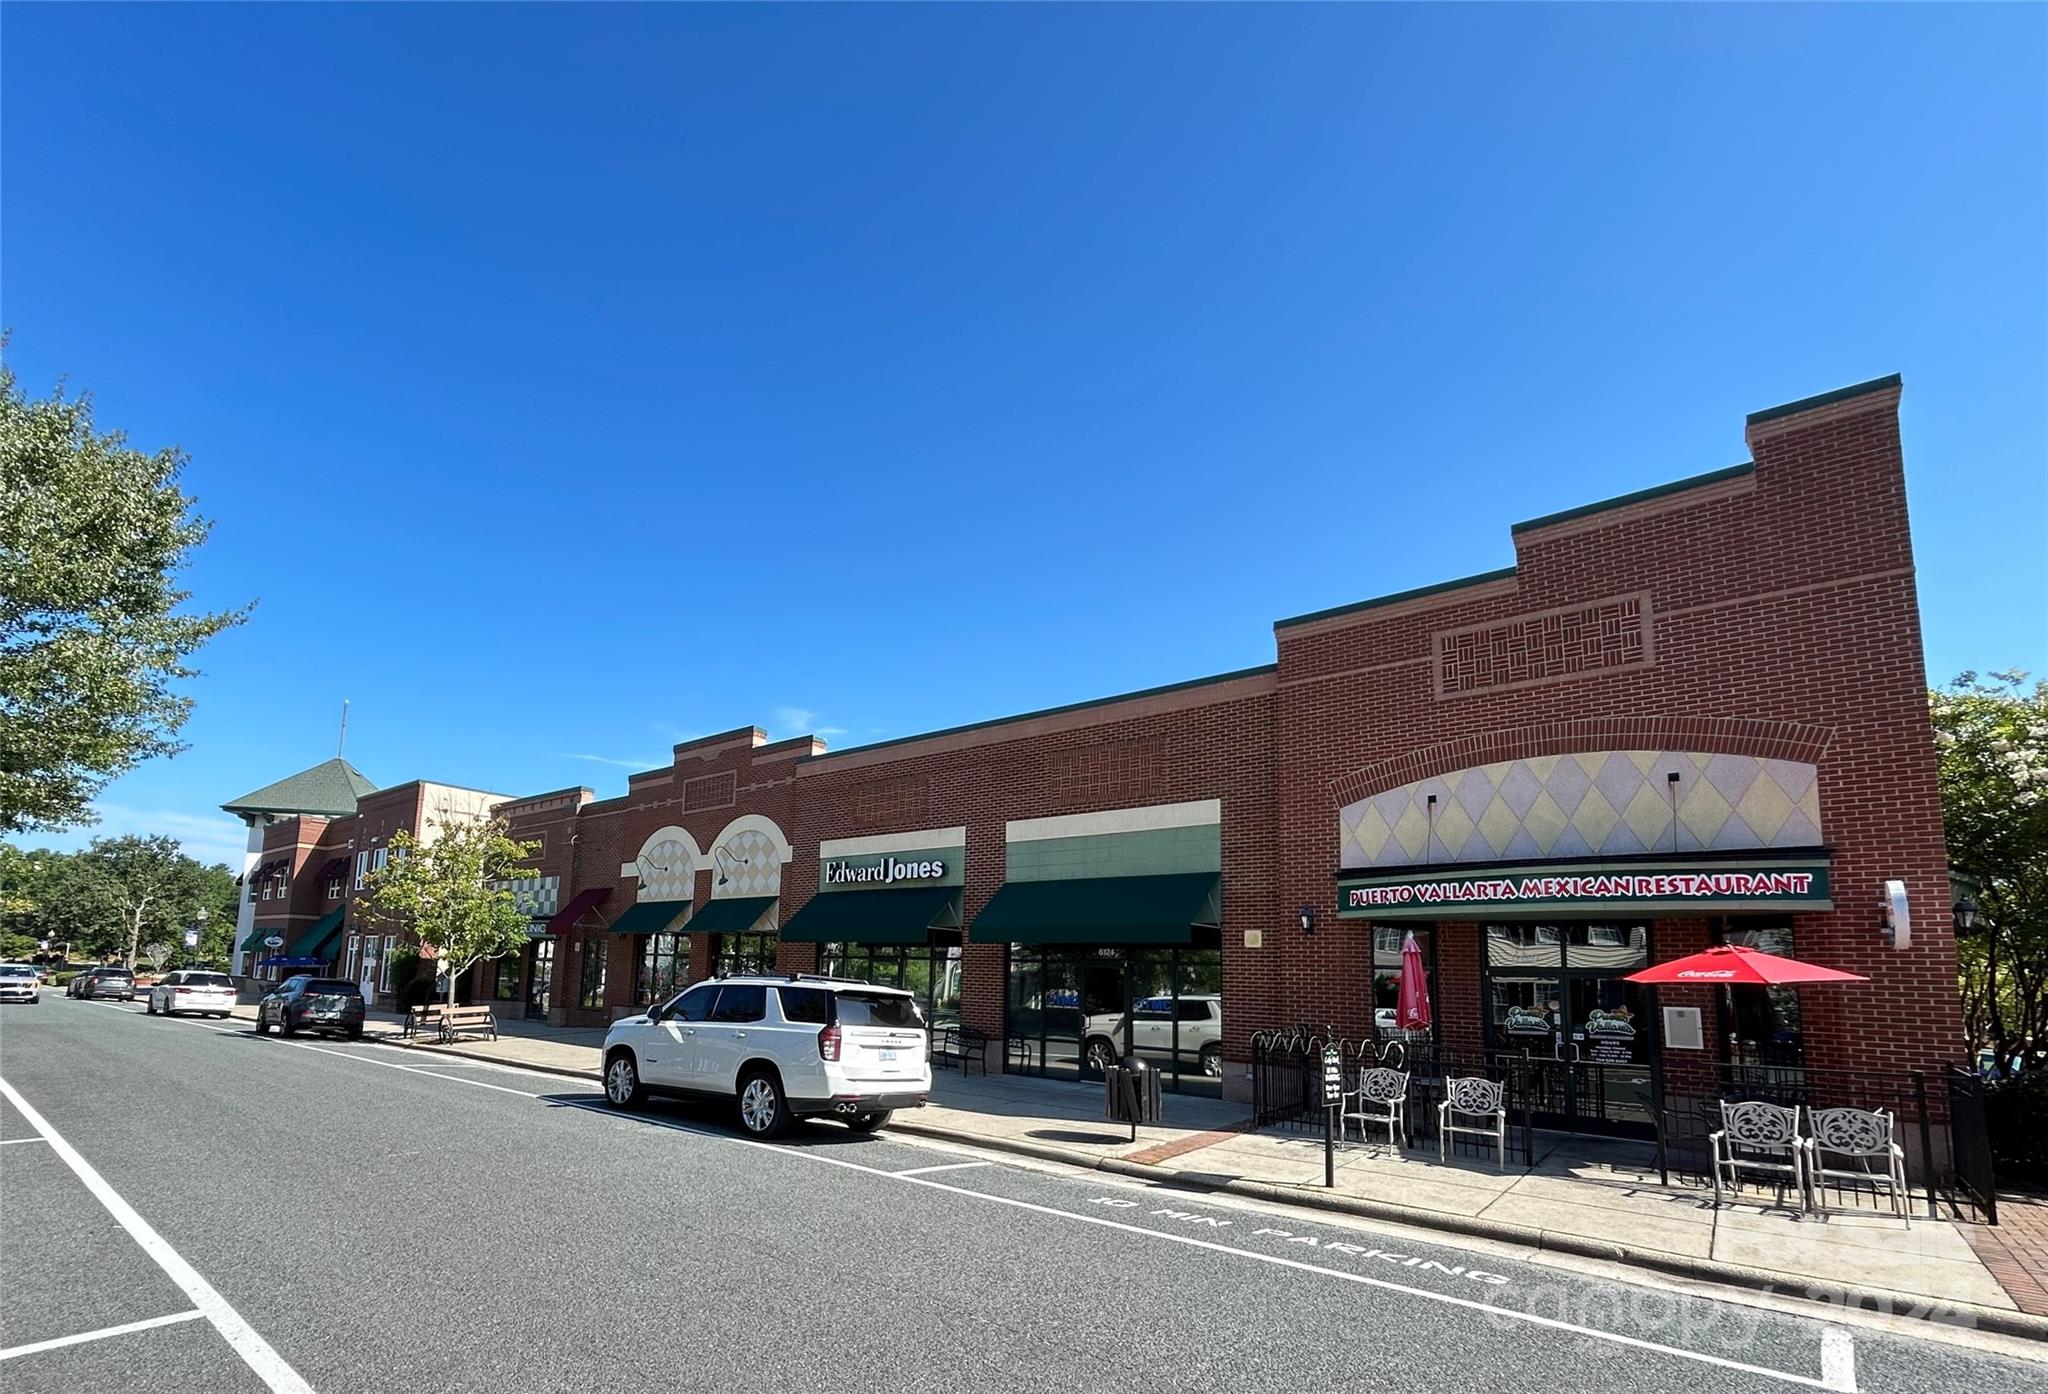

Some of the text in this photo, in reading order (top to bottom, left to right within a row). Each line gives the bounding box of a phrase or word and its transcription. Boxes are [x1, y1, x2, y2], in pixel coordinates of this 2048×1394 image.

[826, 858, 943, 883] Edward Jones
[1350, 873, 1813, 907] PUERTO VALLARTA MEXICAN RESTAURANT
[1089, 1196, 1512, 1285] 10 MIN PARKING
